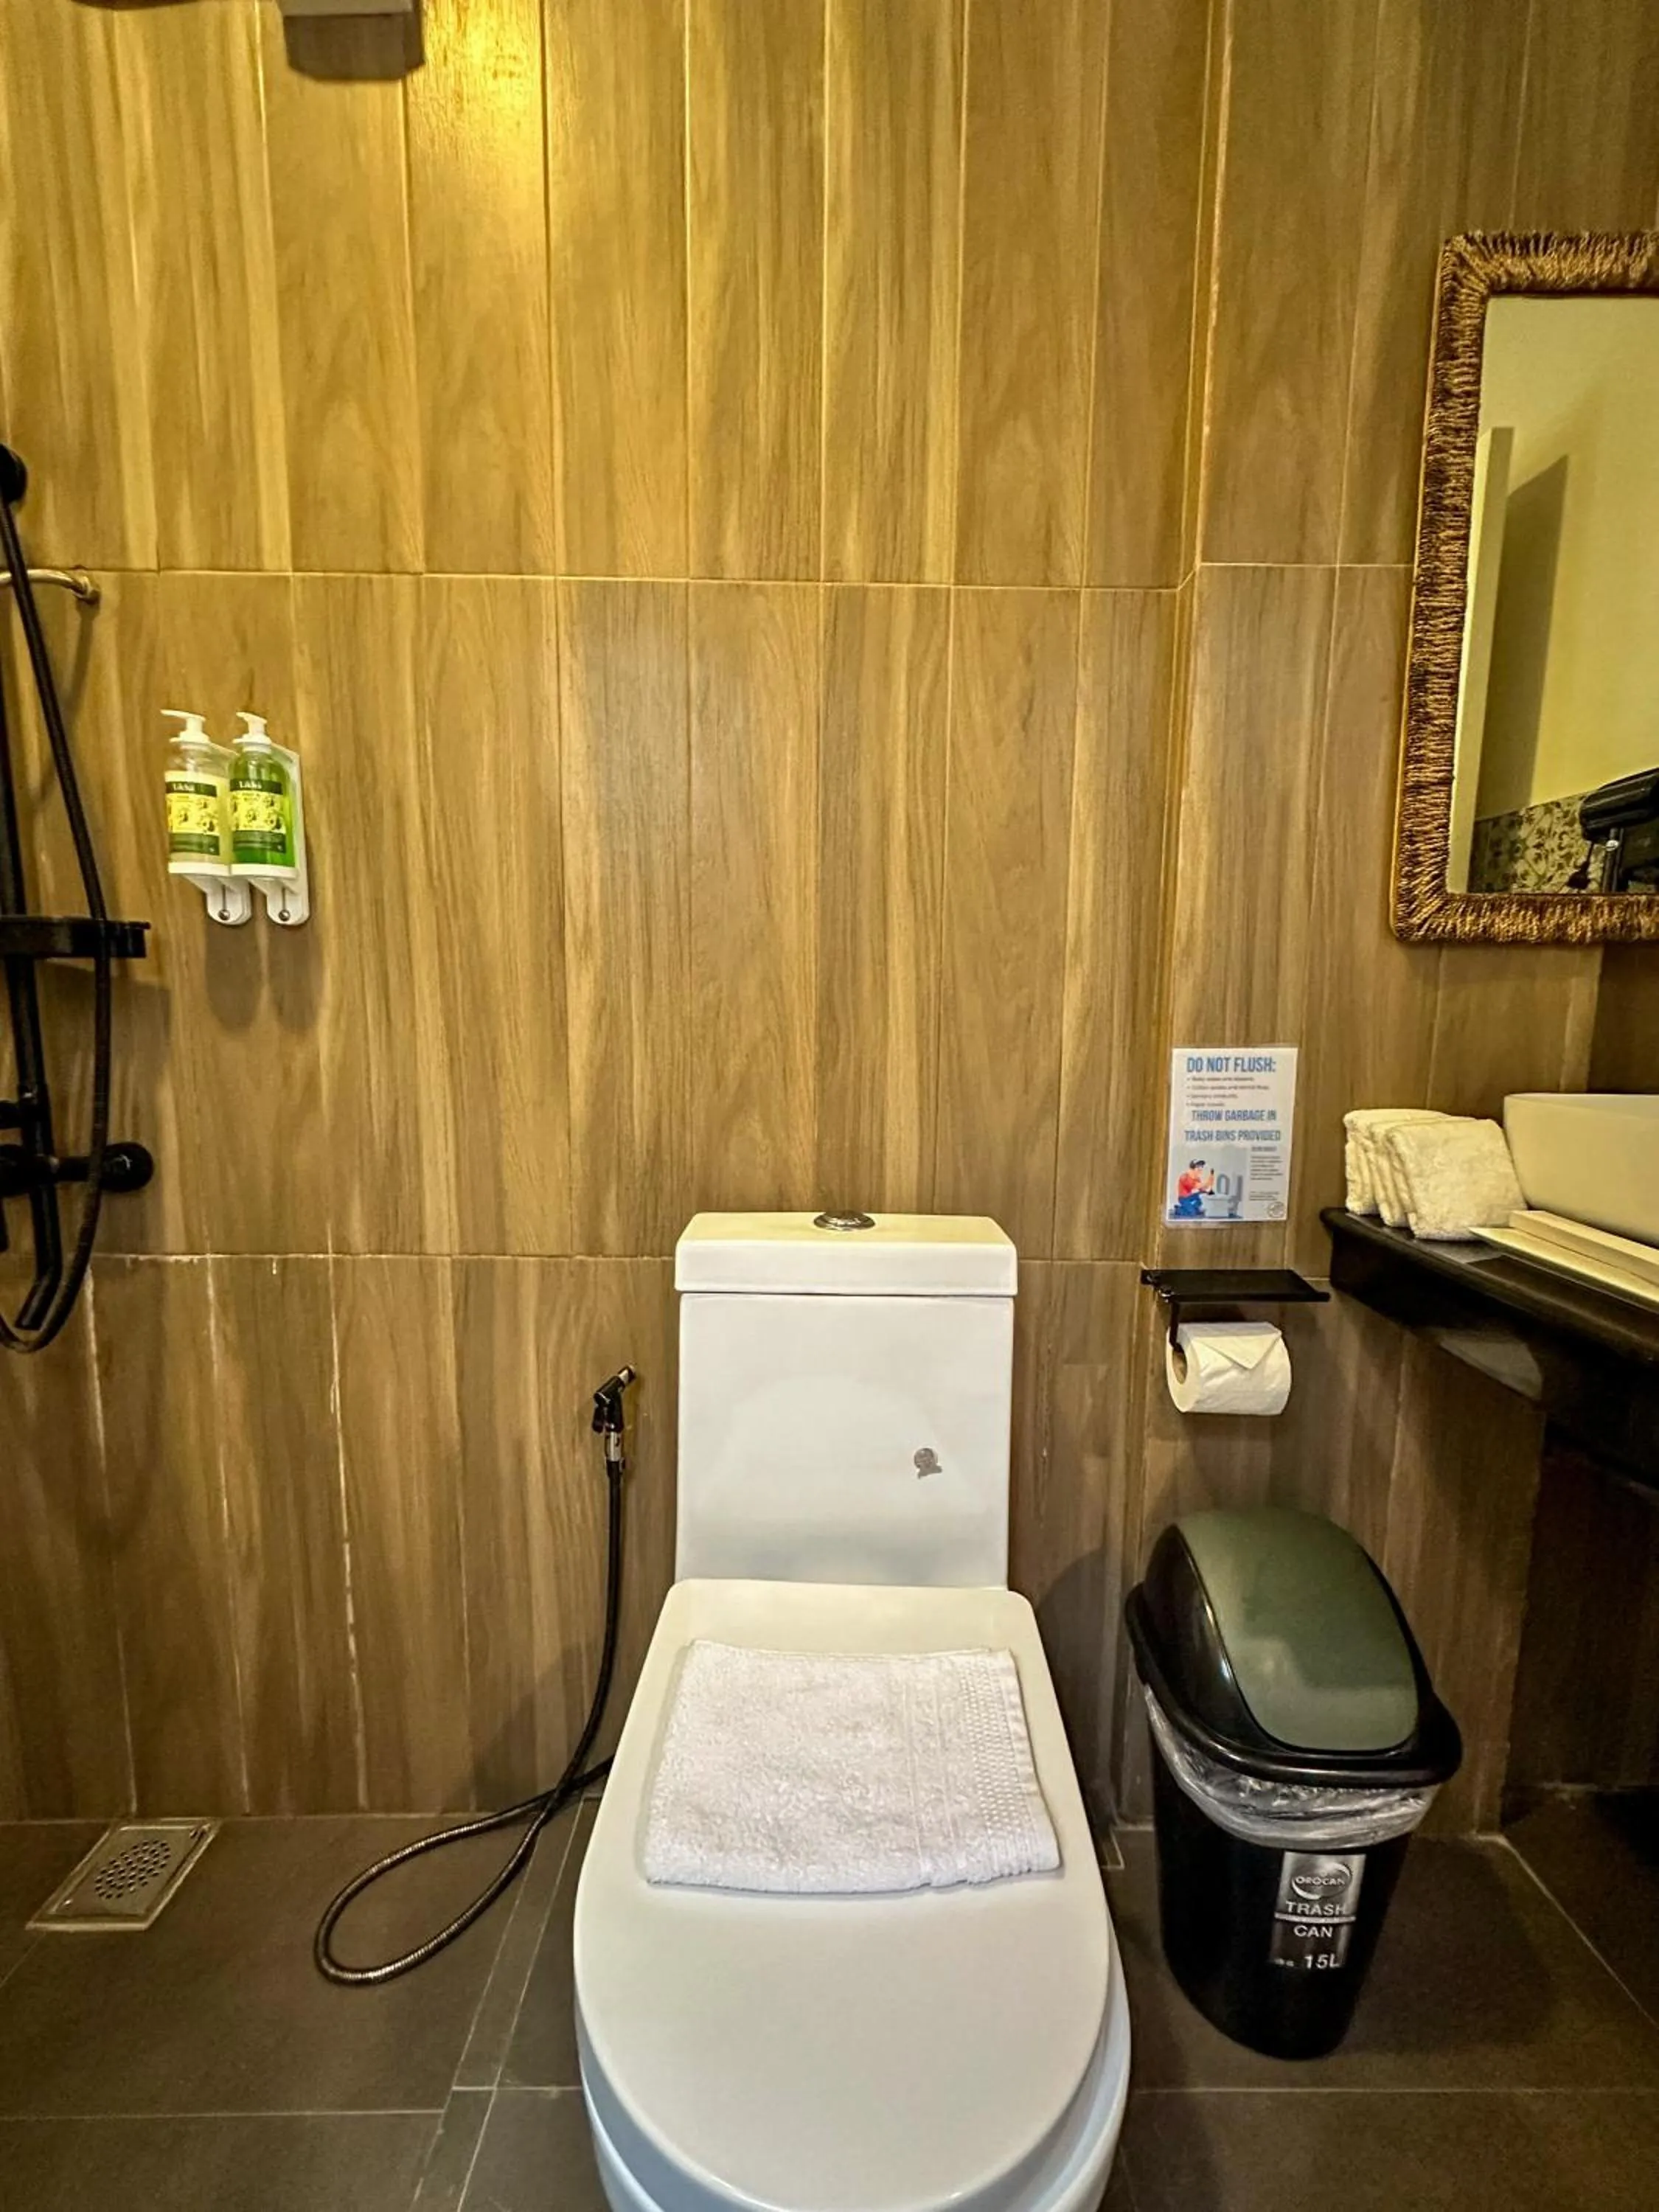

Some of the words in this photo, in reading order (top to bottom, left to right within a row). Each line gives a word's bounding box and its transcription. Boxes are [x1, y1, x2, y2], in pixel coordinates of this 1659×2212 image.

[1186, 1057, 1203, 1072] DO
[1206, 1057, 1230, 1072] NOT
[1192, 1110, 1222, 1121] THROW
[1225, 1110, 1265, 1121] GARBAGE
[1267, 1110, 1276, 1121] IN
[1184, 1130, 1213, 1141] TRASH
[1216, 1130, 1236, 1141] BINS
[1238, 1130, 1281, 1141] PROVIDED
[1295, 1876, 1346, 1886] OROCAN
[1286, 1901, 1346, 1916] TRASH
[1293, 1924, 1334, 1938] CAN
[1304, 1954, 1340, 1969] 15L
